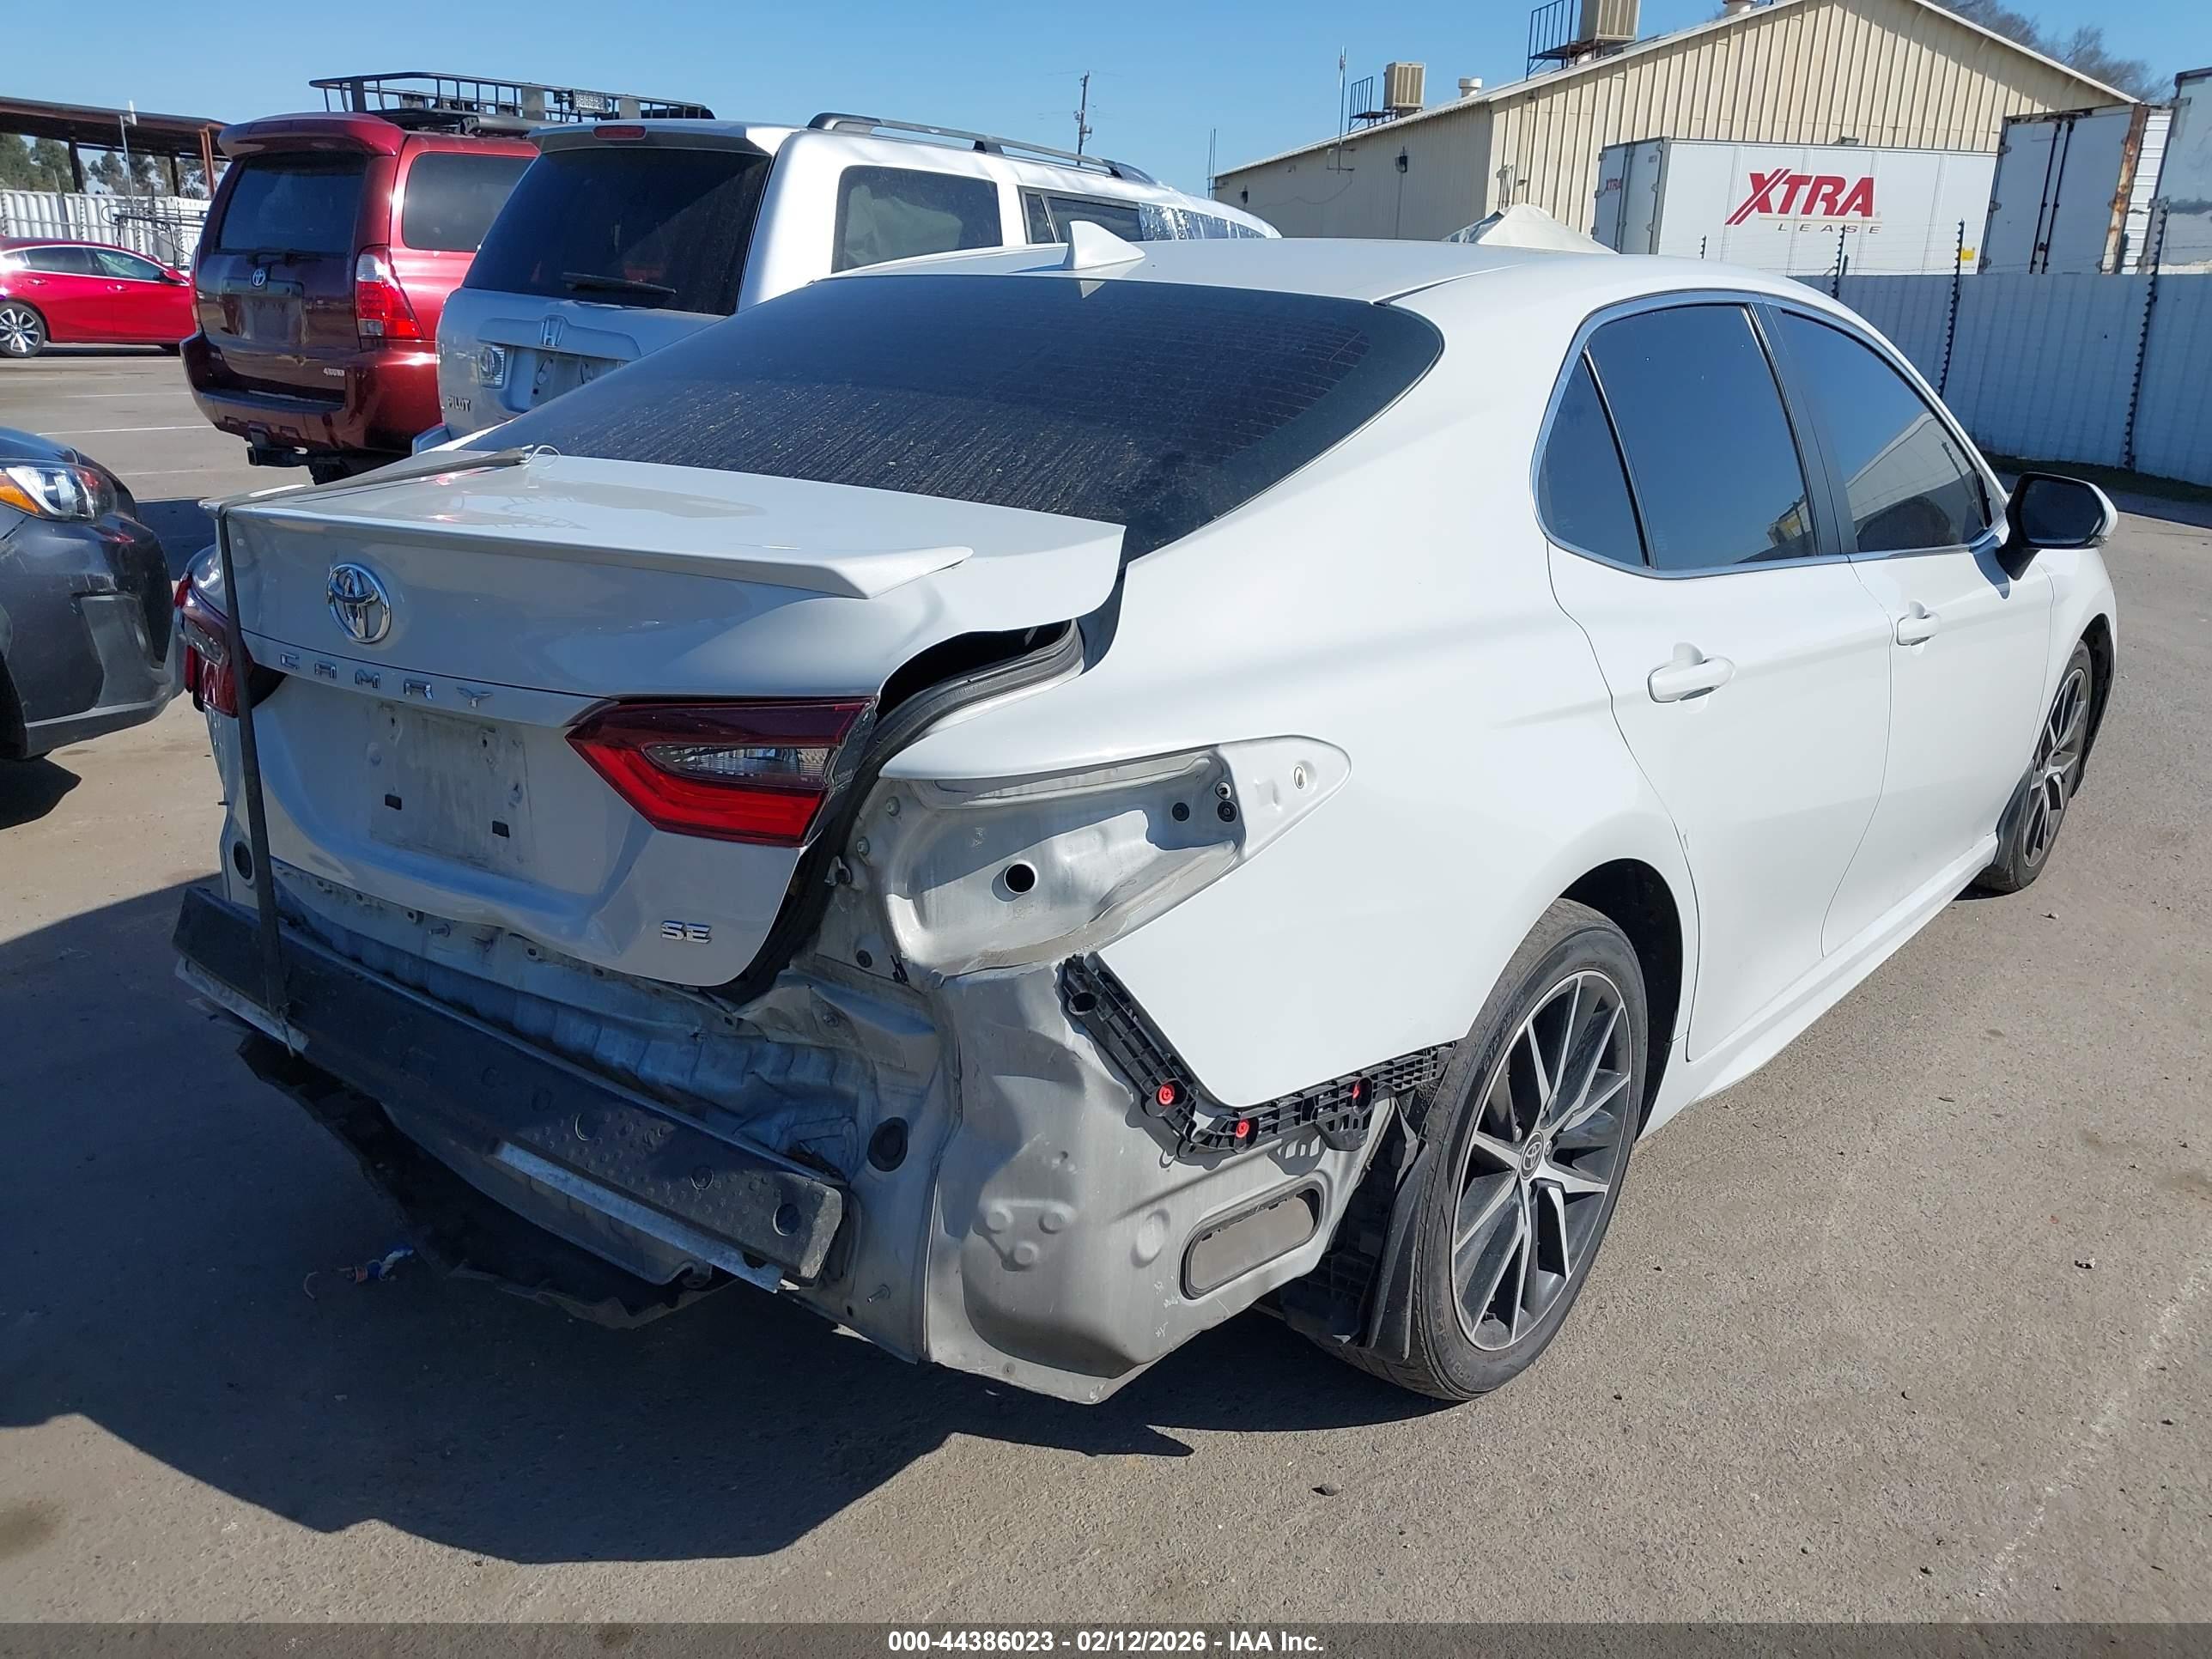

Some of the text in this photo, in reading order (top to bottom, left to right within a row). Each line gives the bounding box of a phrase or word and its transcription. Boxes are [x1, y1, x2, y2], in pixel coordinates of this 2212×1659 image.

[1725, 168, 1874, 225] XTRA
[1778, 223, 1881, 234] LEASE
[447, 395, 471, 412] PILOT
[280, 652, 492, 708] CAMRY
[660, 920, 712, 944] SE
